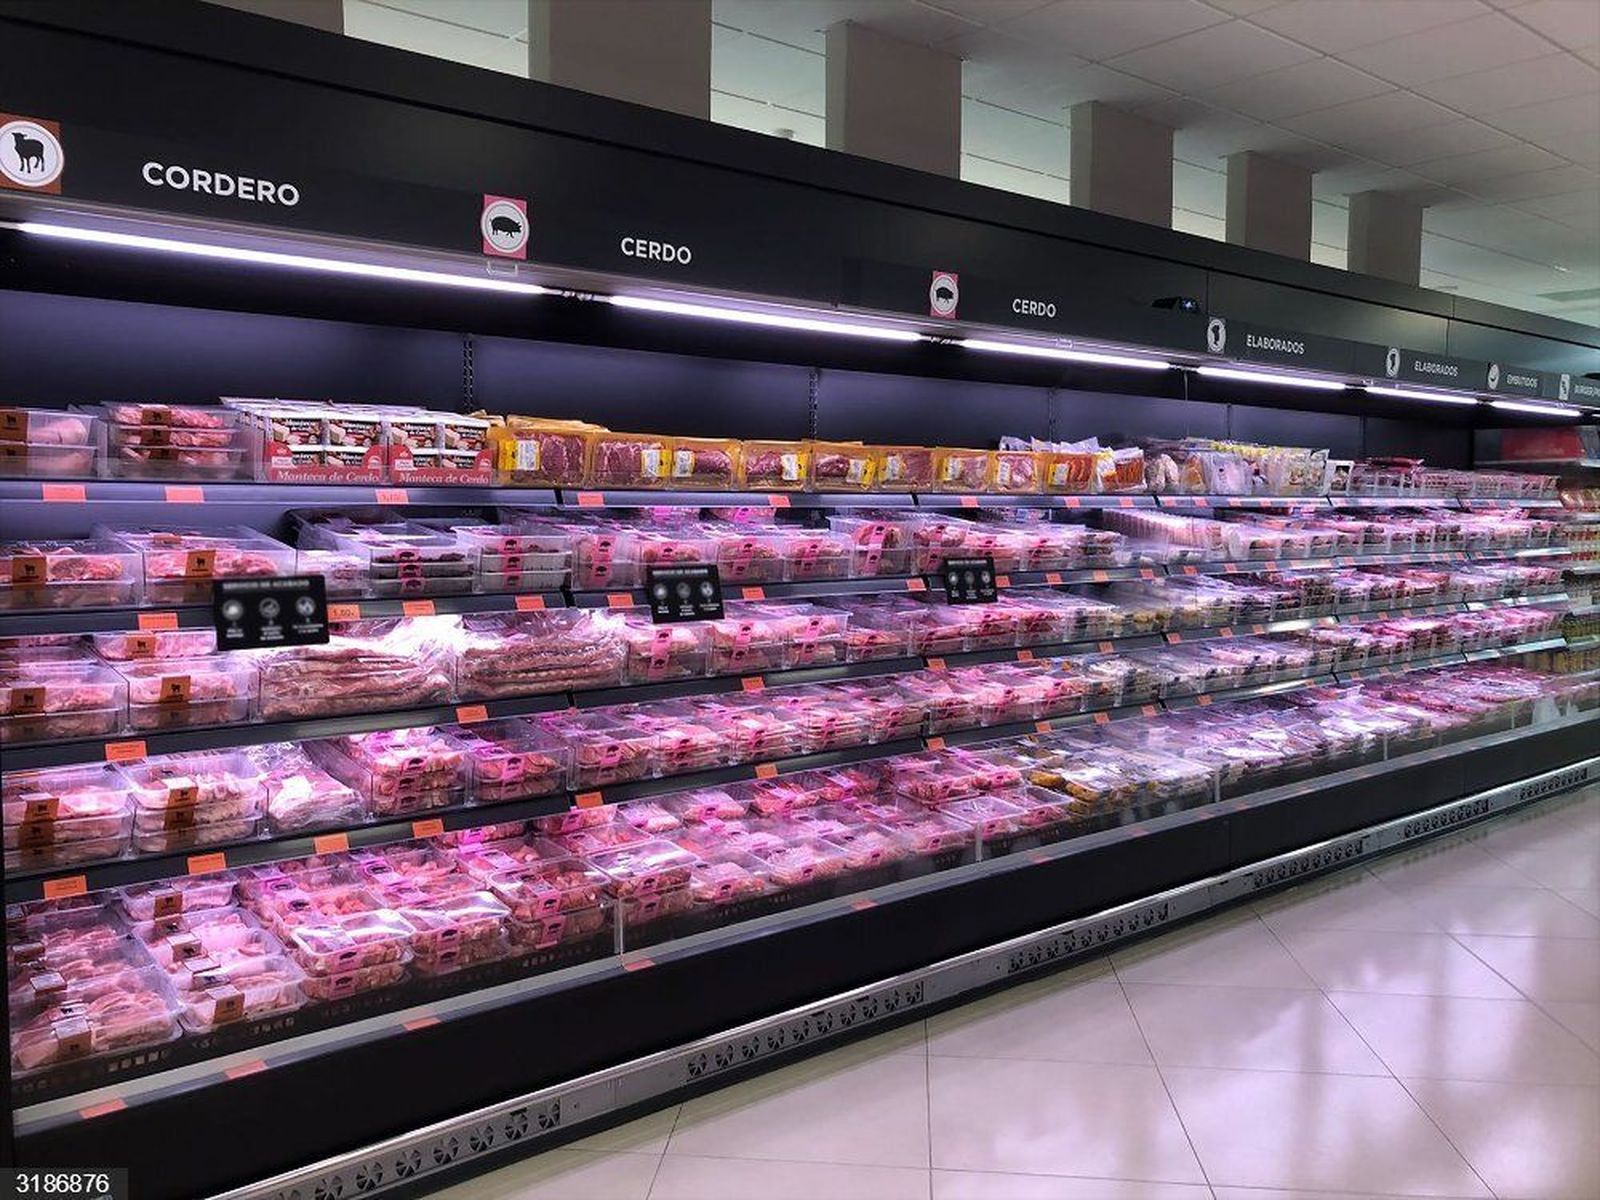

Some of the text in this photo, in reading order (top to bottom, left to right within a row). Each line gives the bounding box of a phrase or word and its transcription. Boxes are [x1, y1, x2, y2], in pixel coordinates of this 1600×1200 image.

[141, 161, 300, 206] CORDERO
[621, 237, 692, 264] CERDO
[1012, 298, 1057, 318] CERDO
[1246, 333, 1305, 354] ELABORADOS
[1414, 360, 1459, 377] ELABORADOS
[278, 471, 380, 482] Manteca de Cerdo
[399, 472, 489, 484] Manteca de Cerdo
